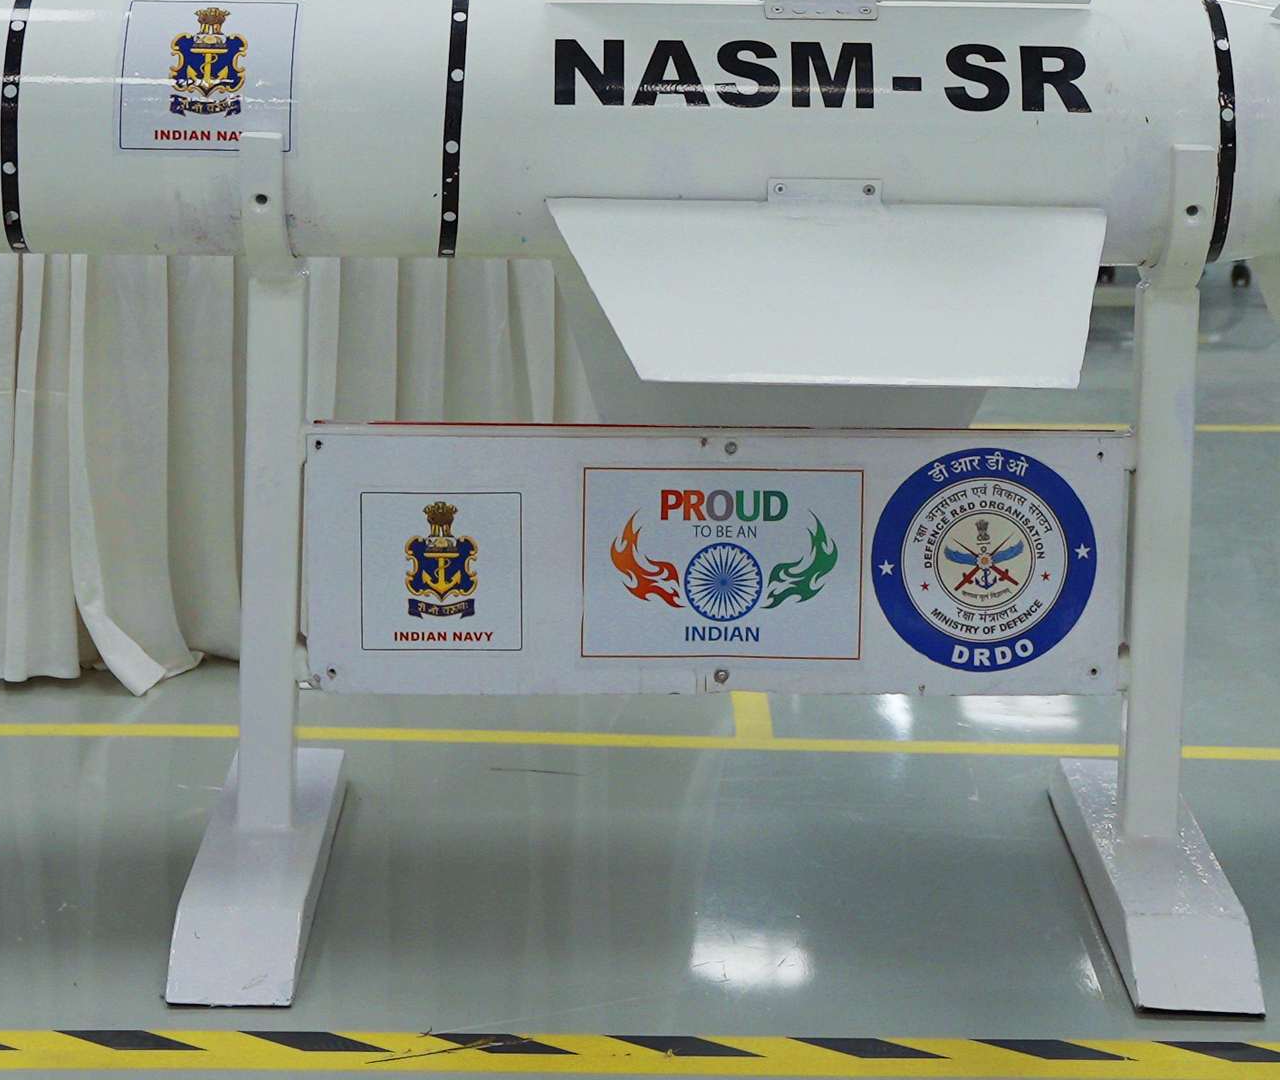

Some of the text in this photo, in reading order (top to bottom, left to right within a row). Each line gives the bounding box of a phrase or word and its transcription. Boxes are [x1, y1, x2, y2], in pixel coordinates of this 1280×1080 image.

[553, 38, 1092, 113] NASM-SR
[154, 130, 242, 141] INDIAN NA
[928, 451, 1029, 482] डी आर डी ओ
[661, 489, 789, 522] PROUD
[992, 483, 1027, 506] विकास
[692, 525, 757, 538] TO BE AN
[924, 500, 1045, 569] DEFENCE R&D ORGANISATION
[930, 599, 1043, 635] MINISTRY OF DEFENCE
[394, 632, 494, 641] INDIAN NAVY
[685, 626, 760, 642] INDIAN
[951, 638, 1034, 667] DRDO
